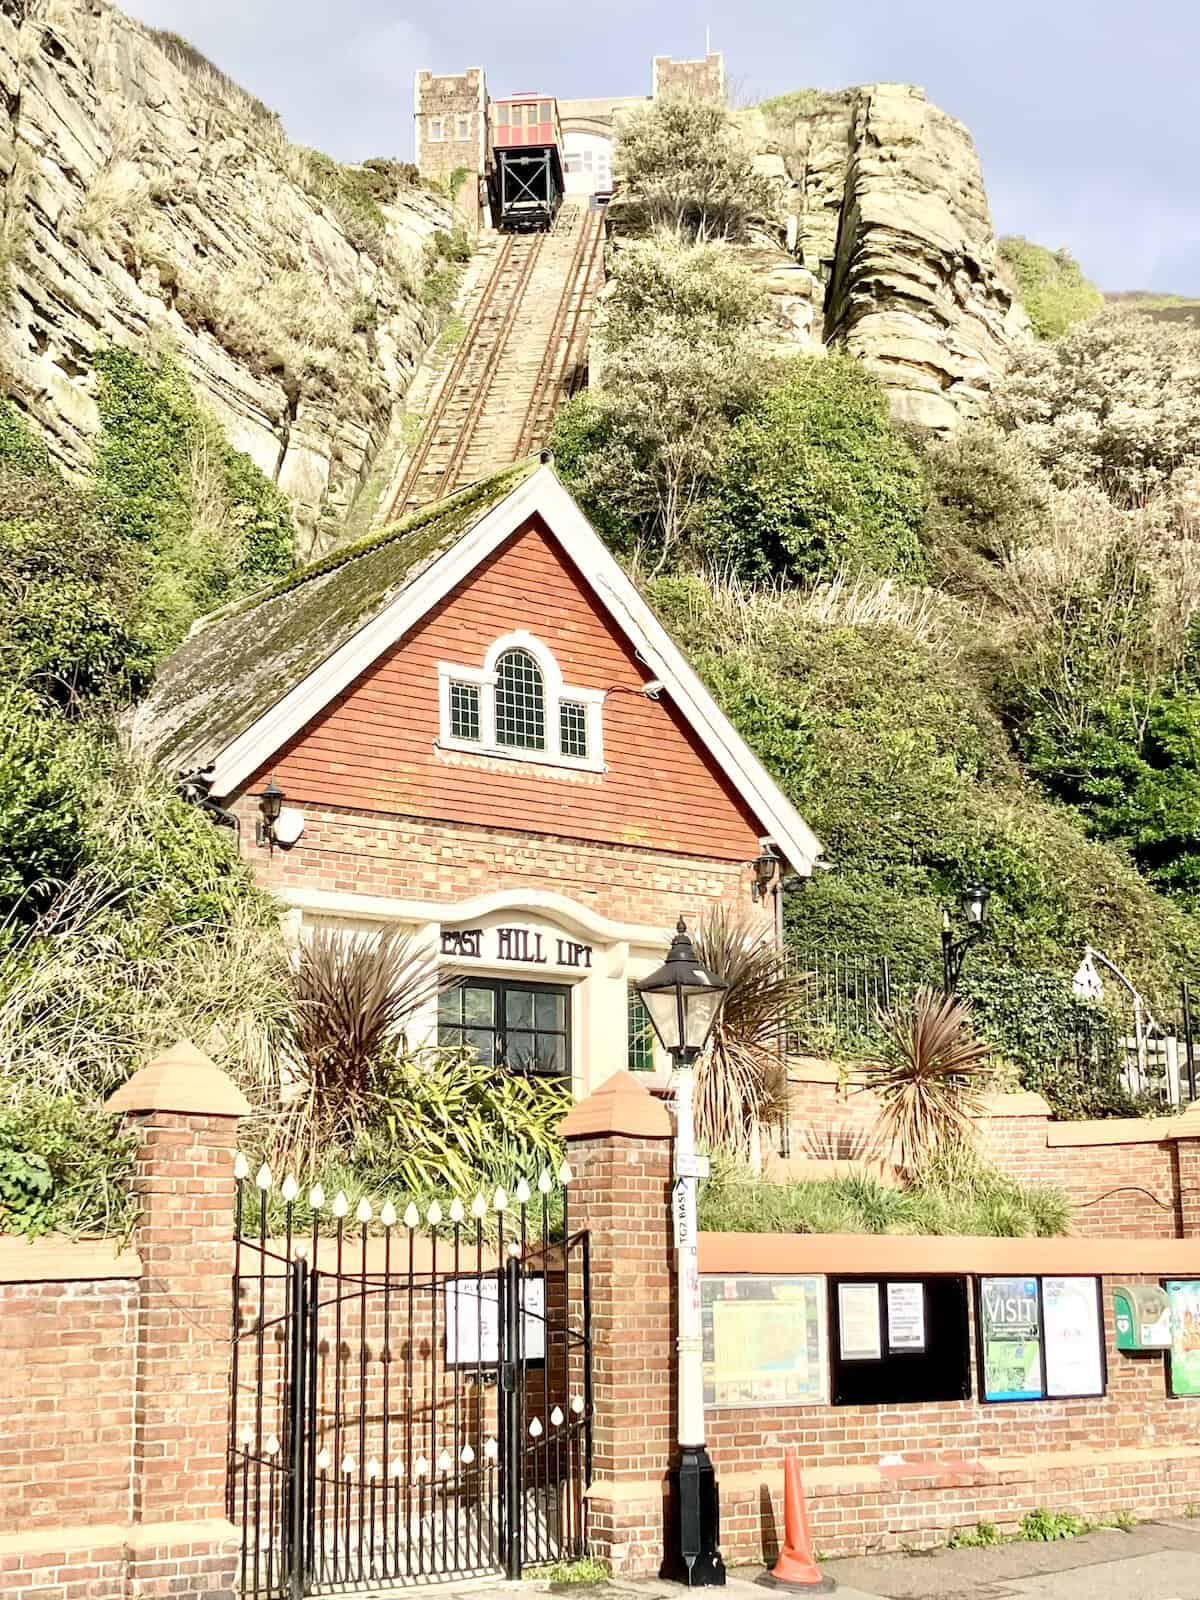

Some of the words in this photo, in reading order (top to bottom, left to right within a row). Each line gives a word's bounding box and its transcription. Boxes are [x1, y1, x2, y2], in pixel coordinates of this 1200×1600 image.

[440, 929, 484, 958] EAST
[496, 928, 547, 963] HILL
[556, 938, 593, 968] LIFT
[984, 1295, 1035, 1322] VISIT
